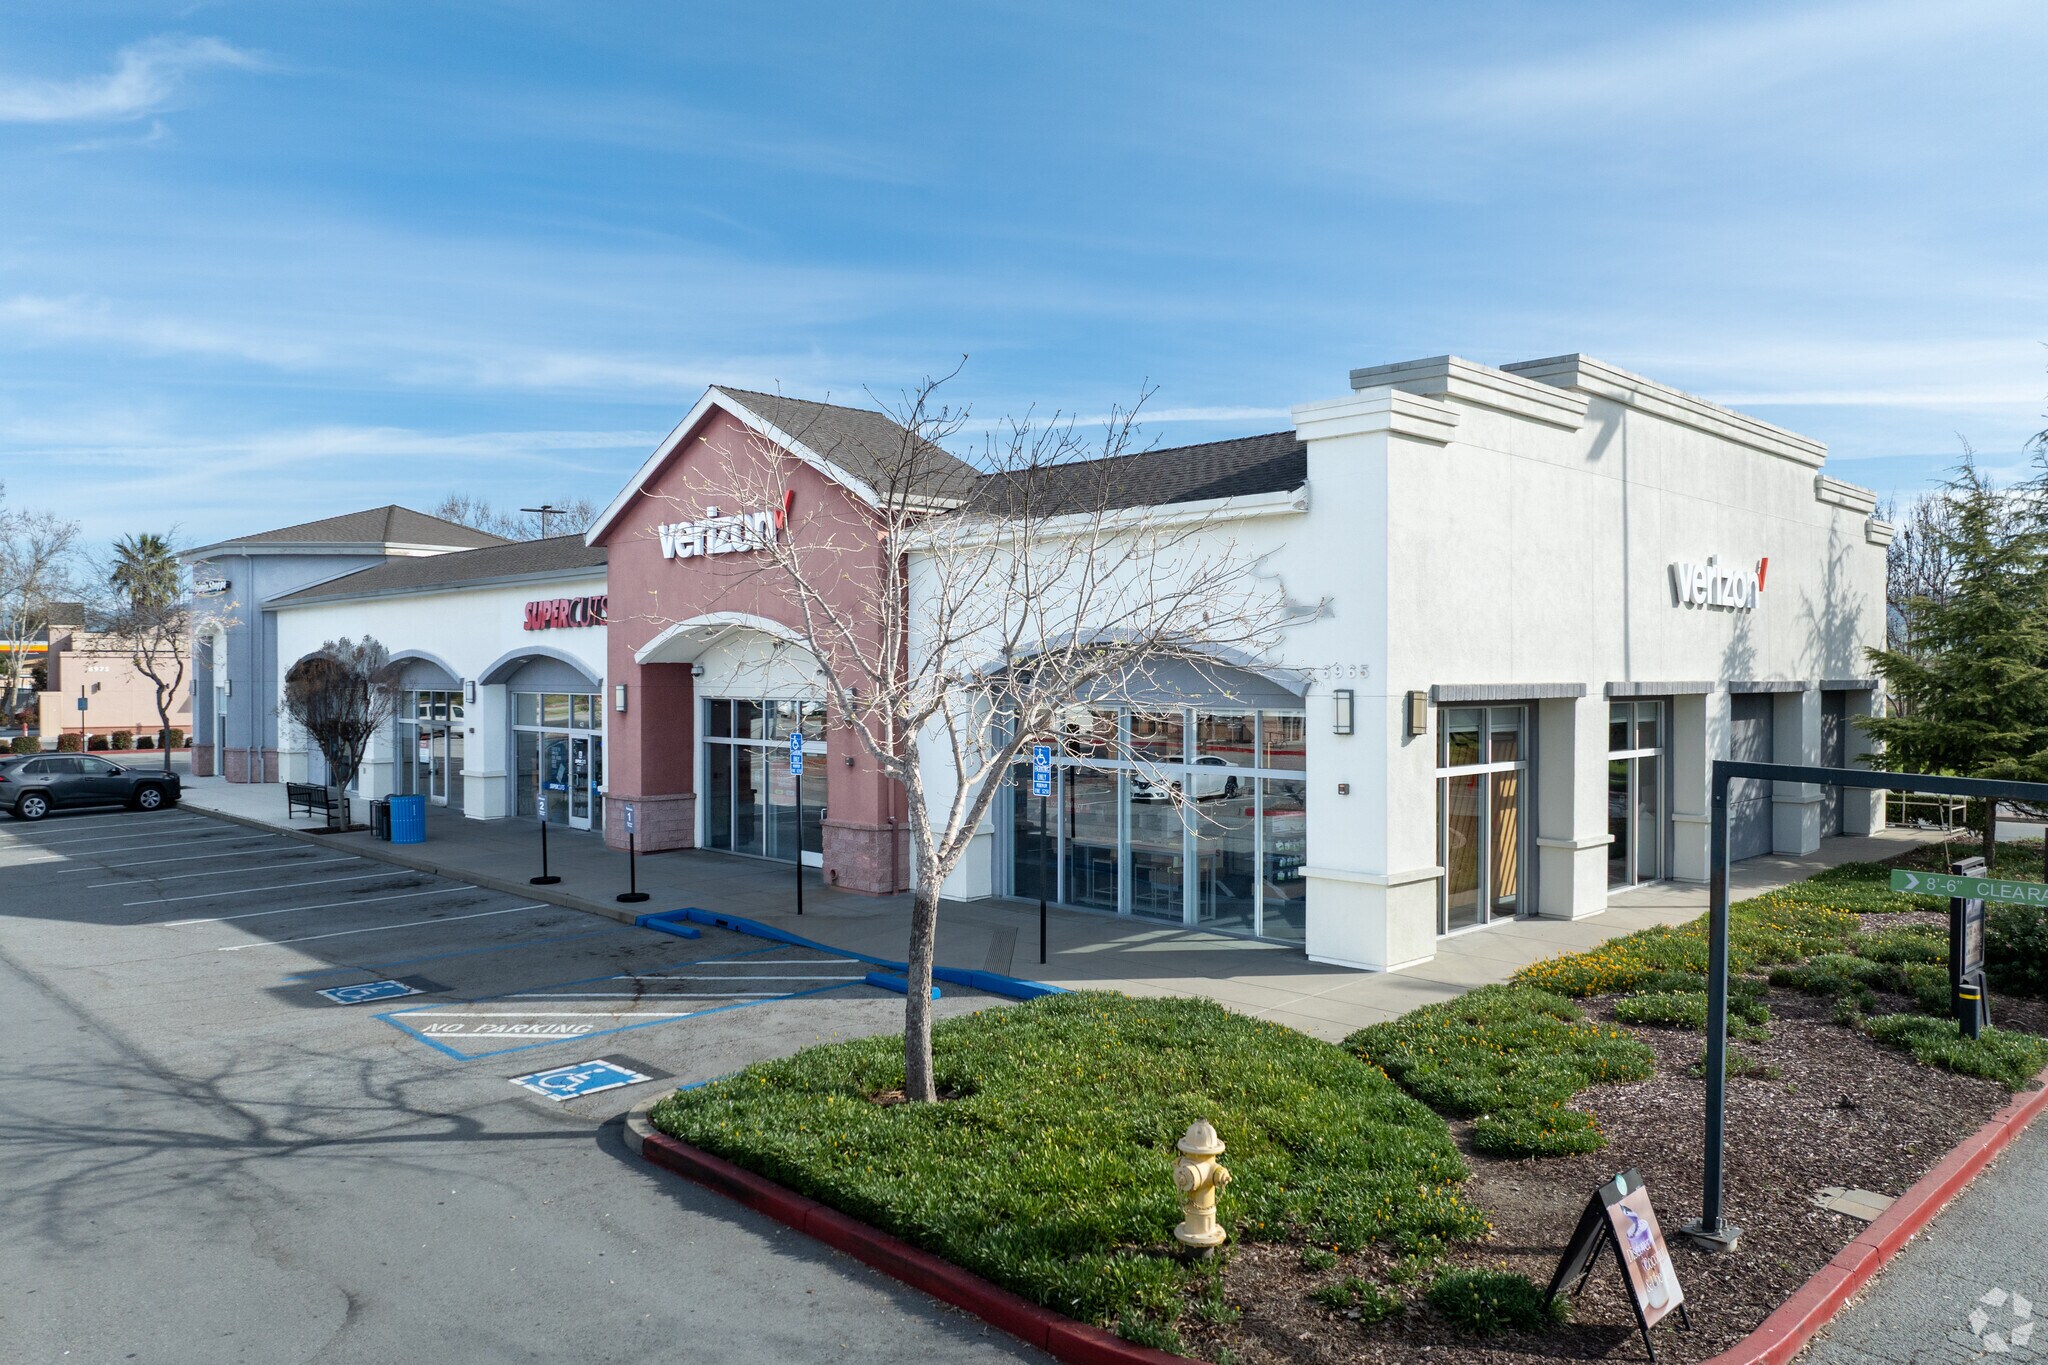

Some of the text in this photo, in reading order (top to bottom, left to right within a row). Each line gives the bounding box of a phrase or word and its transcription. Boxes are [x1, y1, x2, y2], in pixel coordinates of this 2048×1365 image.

[658, 506, 778, 559] verizon
[1672, 554, 1760, 609] verizon
[524, 595, 608, 631] SUPERCUTS
[1322, 664, 1370, 680] 6965
[421, 1023, 594, 1033] NO PARKING
